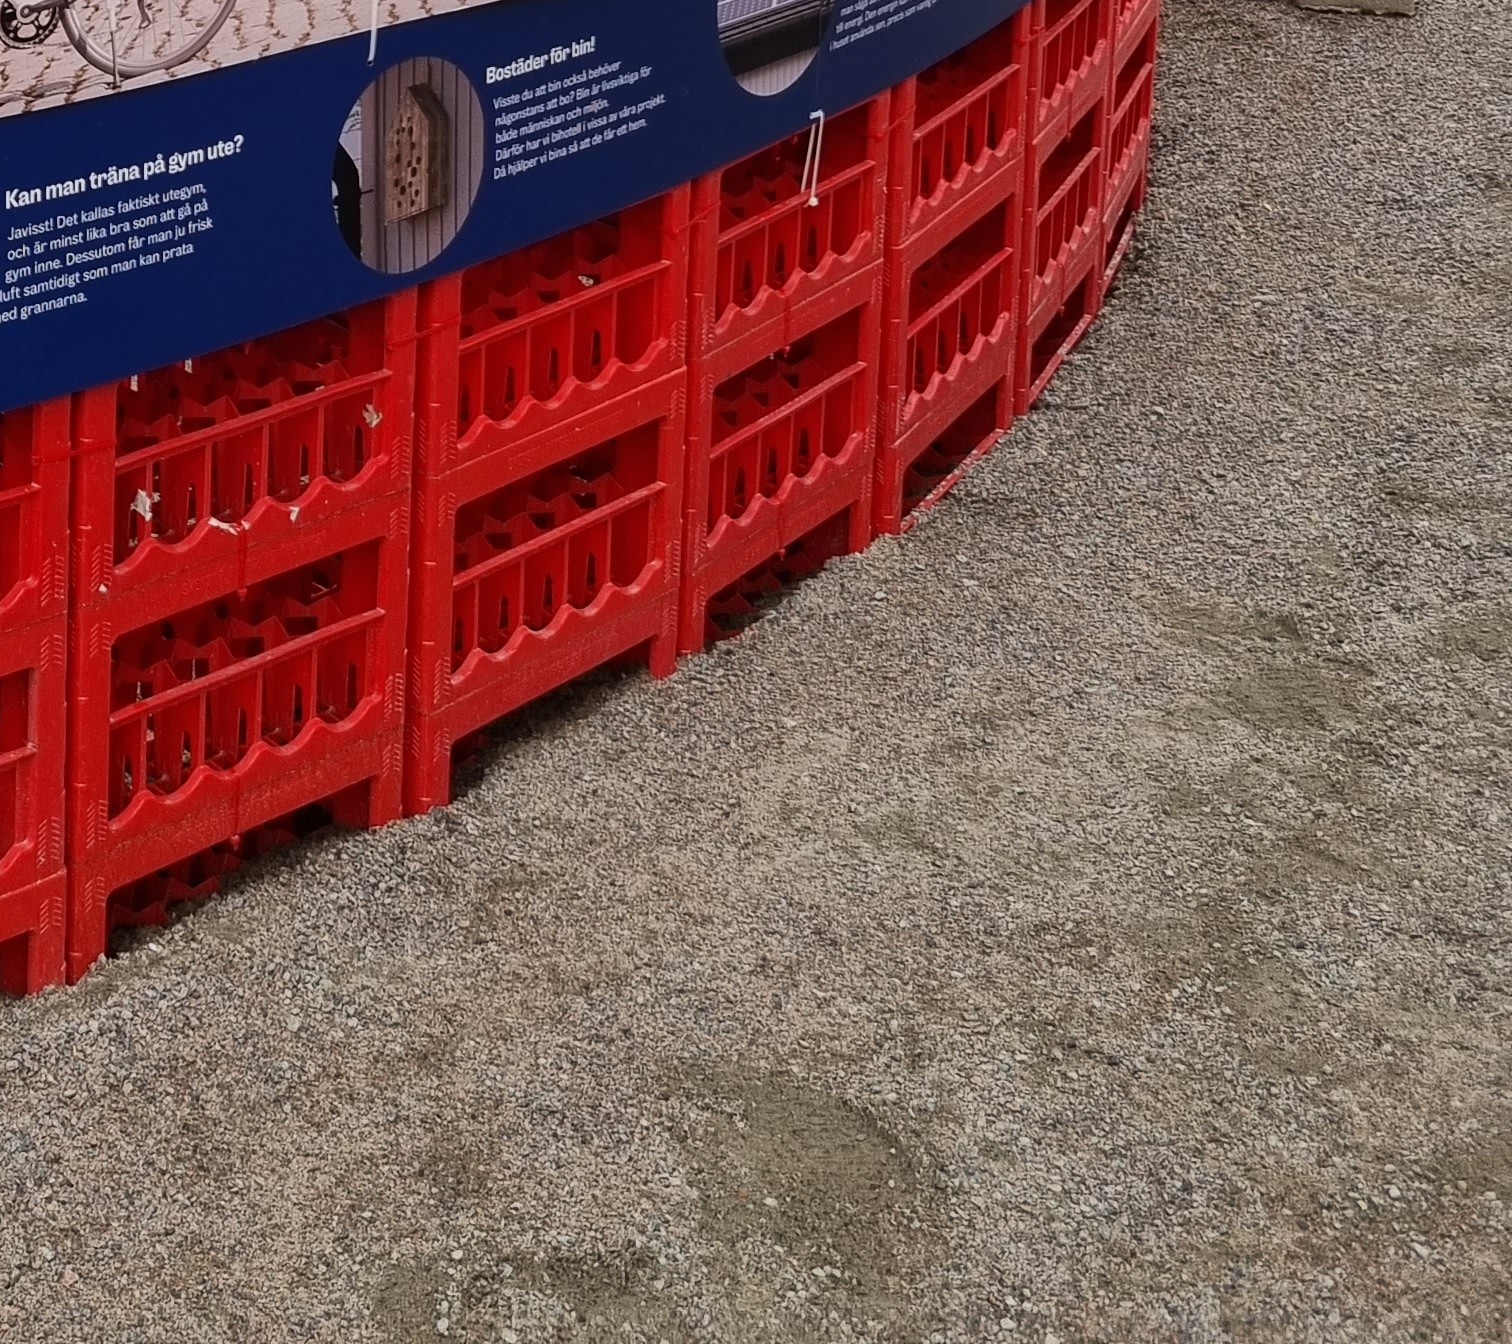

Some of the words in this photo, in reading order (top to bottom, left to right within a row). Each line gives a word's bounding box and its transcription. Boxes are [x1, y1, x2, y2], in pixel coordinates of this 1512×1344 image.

[486, 54, 549, 84] Bostäder
[549, 45, 571, 65] för
[571, 35, 596, 58] bin!
[5, 187, 42, 210] Kan
[45, 177, 86, 201] man
[88, 165, 141, 190] träna
[143, 153, 166, 181] på
[168, 148, 204, 174] gym
[207, 134, 244, 161] ute?
[7, 217, 54, 241] Javisst!
[56, 213, 79, 229] Det
[80, 206, 116, 224] kallas
[117, 192, 160, 214] faktiskt
[162, 183, 207, 203] utegym,
